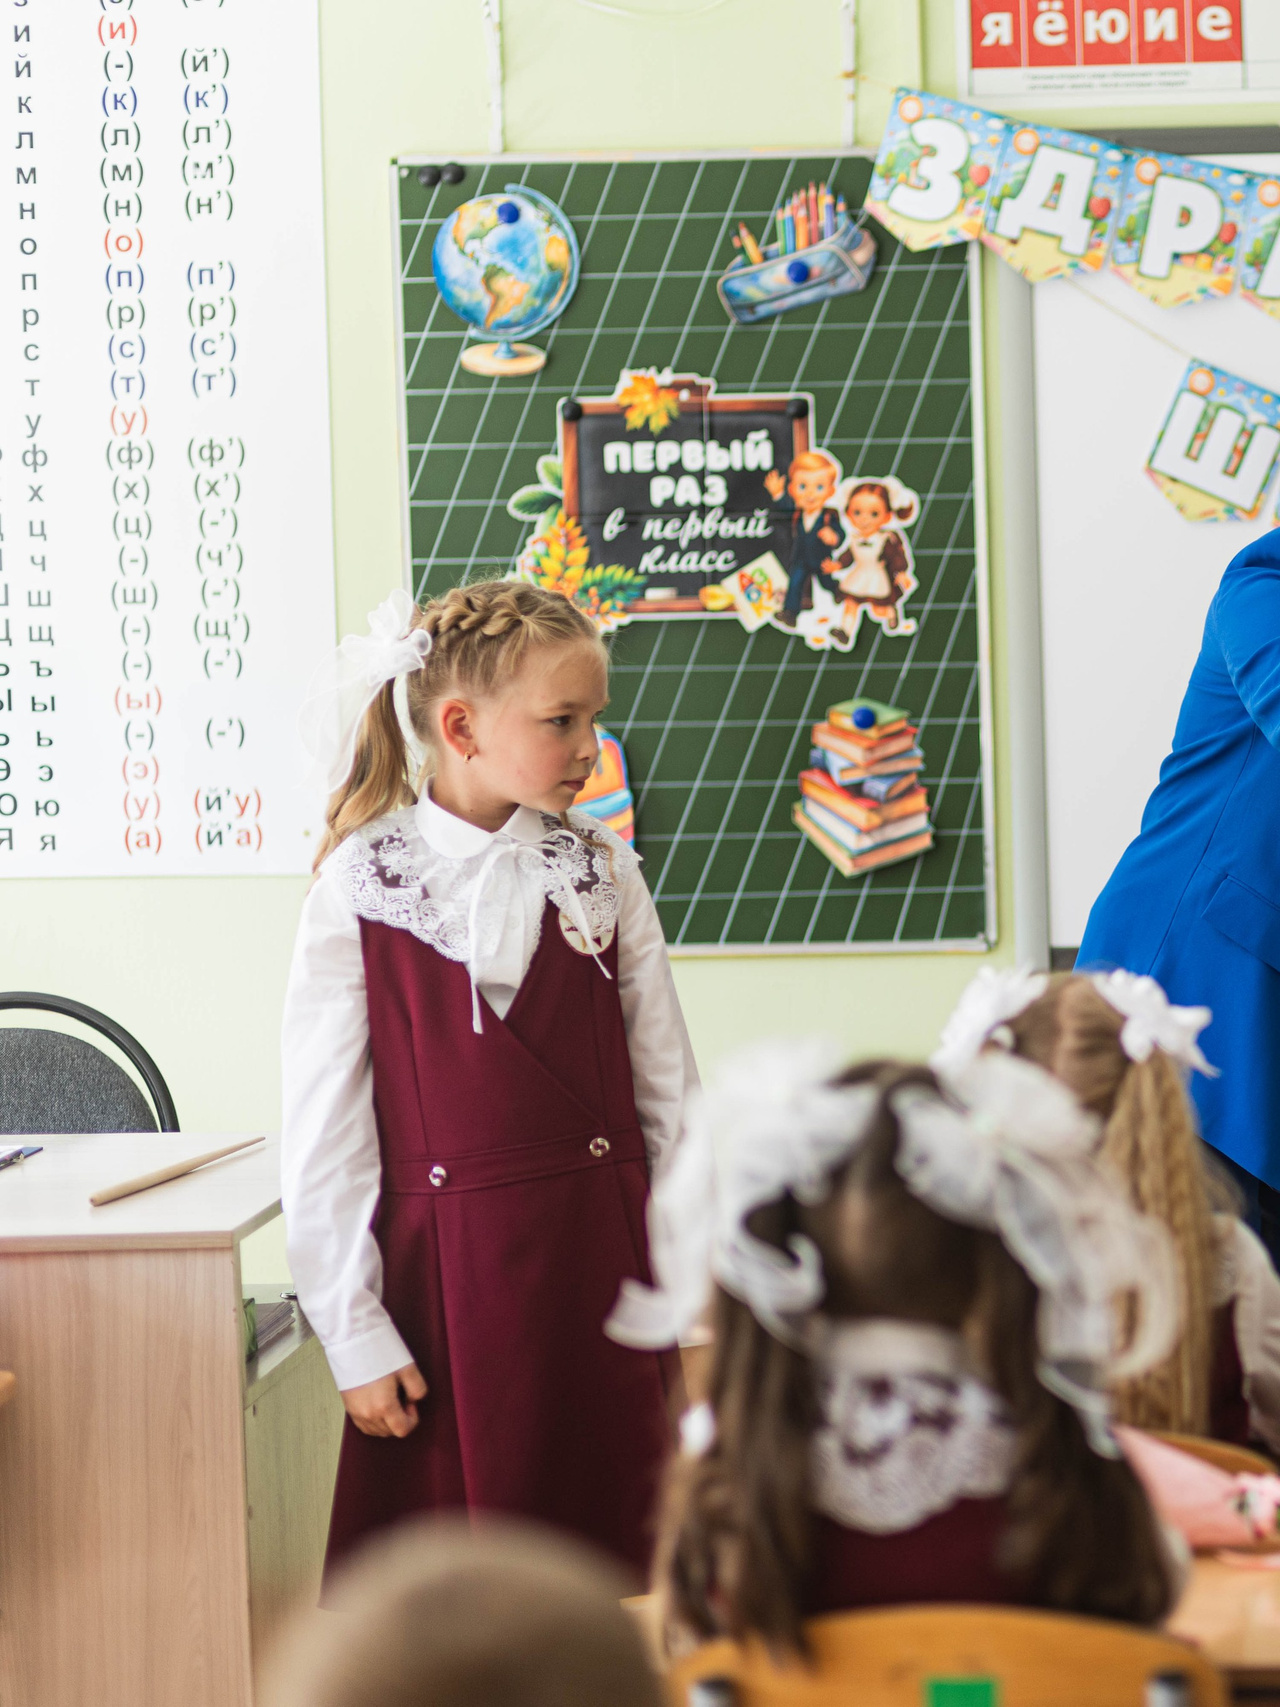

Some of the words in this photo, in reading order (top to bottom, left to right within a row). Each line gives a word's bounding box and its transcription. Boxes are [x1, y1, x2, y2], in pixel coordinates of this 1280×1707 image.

[14, 25, 30, 42] и
[98, 15, 137, 46] (и)
[980, 12, 1014, 46] я
[1033, 0, 1069, 46] ё
[1083, 8, 1130, 43] ю
[1144, 8, 1178, 42] и
[1197, 5, 1232, 41] е
[15, 53, 31, 78] й
[18, 96, 32, 113] к
[102, 86, 137, 117] (к)
[15, 131, 34, 149] л
[100, 121, 141, 153] (л)
[16, 167, 36, 184] м
[100, 157, 144, 188] (м)
[19, 202, 35, 220] н
[103, 192, 142, 224] (н)
[20, 237, 37, 255] о
[104, 228, 143, 259] (о)
[21, 273, 37, 290] п
[105, 263, 144, 294] (п)
[22, 308, 39, 332] р
[106, 299, 145, 330] (р)
[24, 344, 39, 361] с
[108, 334, 145, 365] (с)
[25, 379, 40, 396] т
[110, 370, 145, 400] (т)
[25, 414, 41, 438] у
[110, 405, 148, 435] (у)
[22, 443, 48, 473] ф
[106, 440, 154, 470] (ф)
[603, 429, 773, 473] ПЕРВЫЙ
[28, 485, 43, 502] х
[112, 476, 150, 506] (х)
[649, 475, 728, 507] РАЗ
[29, 520, 47, 541] ц
[112, 511, 152, 541] (ц)
[602, 508, 628, 541] в
[642, 508, 774, 549] первый
[30, 555, 46, 572] ч
[638, 546, 738, 573] класс
[28, 590, 51, 607] ш
[111, 581, 158, 611] (ш)
[29, 625, 54, 646] щ
[30, 660, 53, 677] ъ
[31, 695, 55, 712] ы
[115, 687, 162, 715] (ы)
[36, 730, 53, 747] ь
[38, 764, 53, 782] э
[122, 756, 159, 785] (э)
[35, 800, 60, 817] ю
[124, 792, 160, 820] (у)
[40, 834, 56, 851] я
[125, 826, 162, 855] (а)
